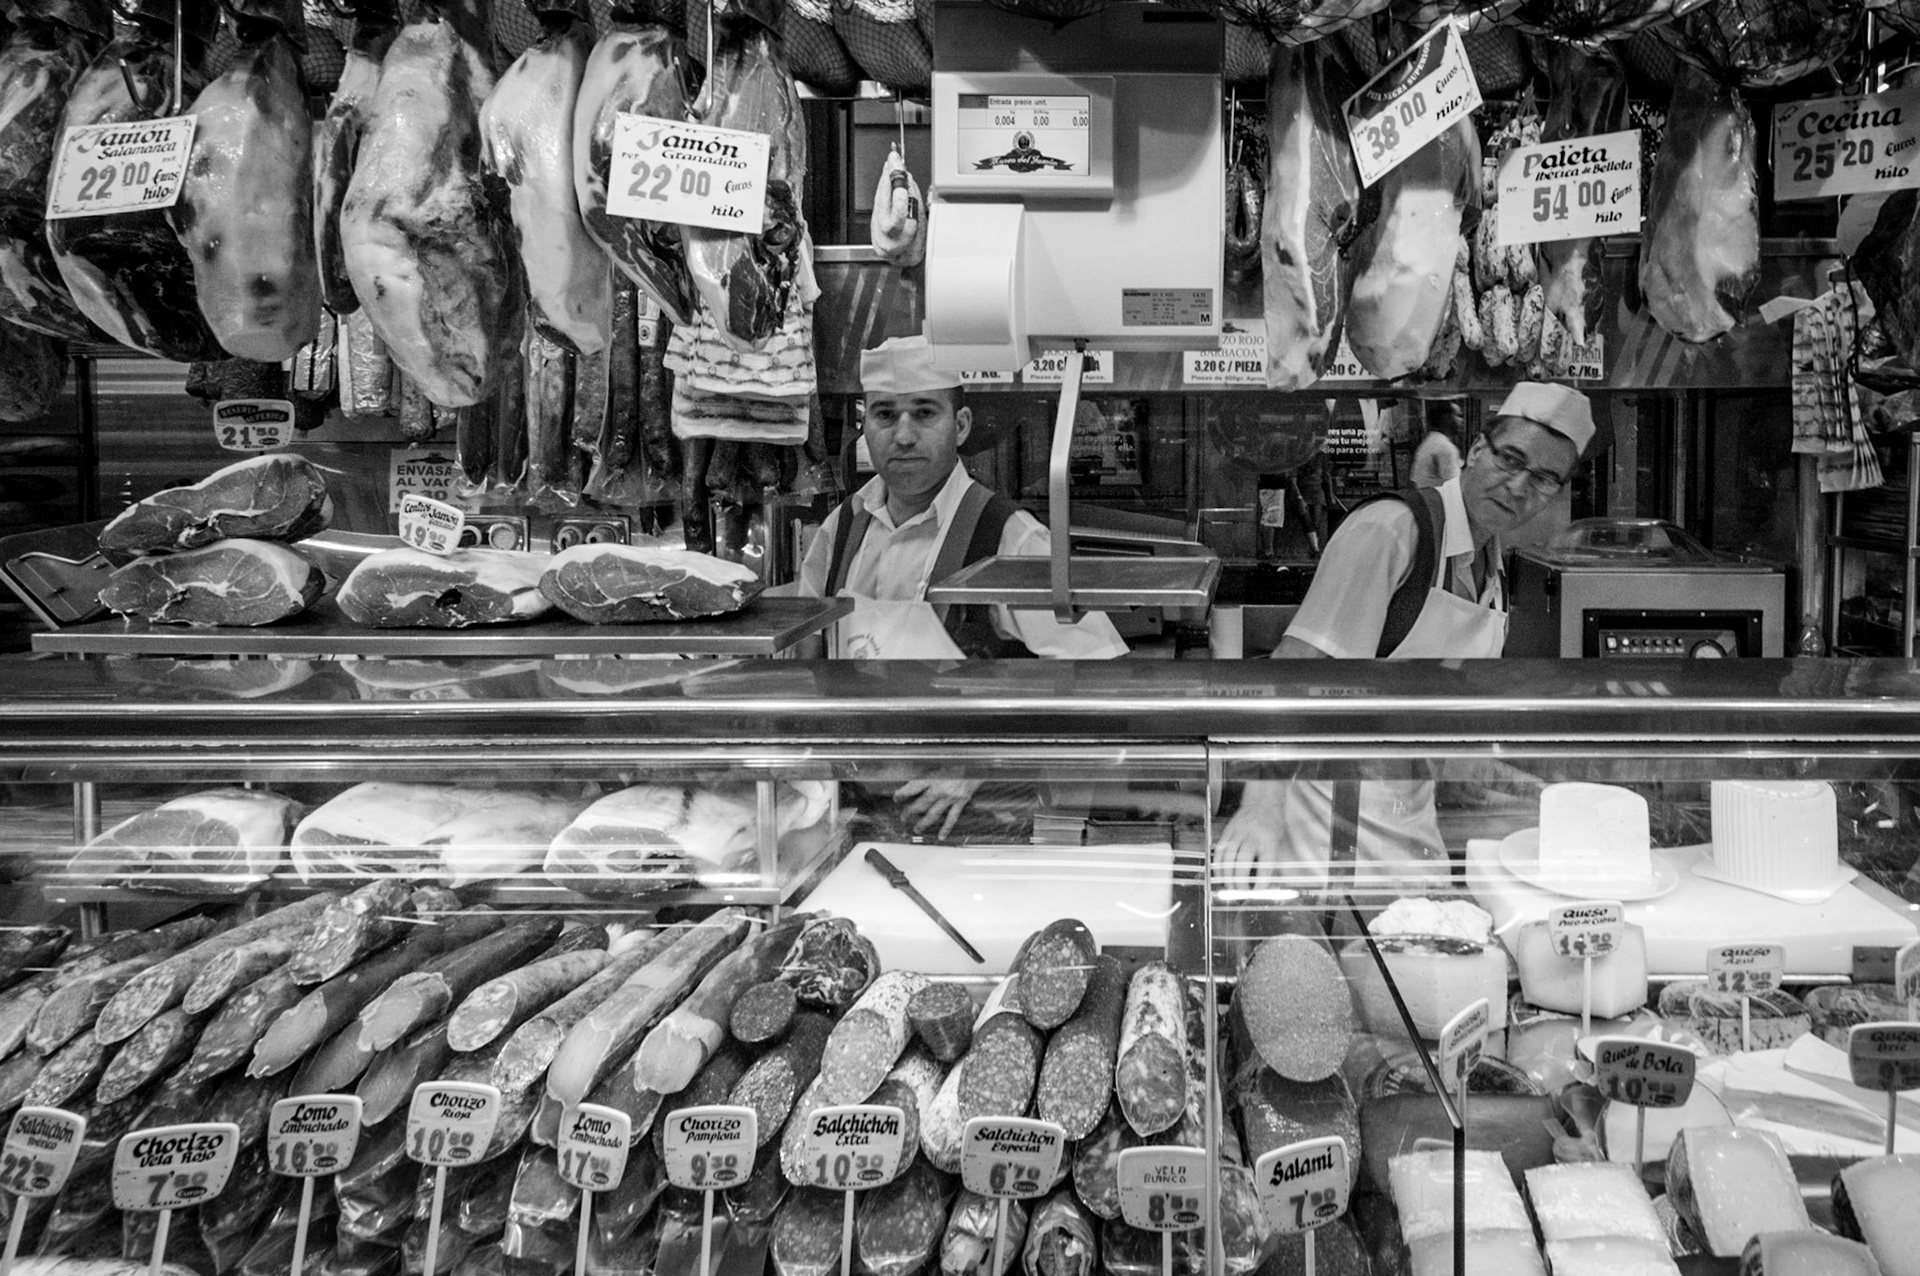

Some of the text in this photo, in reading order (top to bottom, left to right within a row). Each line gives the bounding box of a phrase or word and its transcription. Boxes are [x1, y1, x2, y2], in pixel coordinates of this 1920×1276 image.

[1383, 85, 1408, 101] NEGRA
[1407, 40, 1431, 86] SUPERIOR
[989, 98, 1012, 106] Entrada
[1014, 98, 1032, 107] precio
[994, 115, 1088, 126] 0,004 0,00 0,00
[1797, 105, 1903, 139] Cecina
[76, 128, 172, 154] Jamón
[636, 128, 739, 159] Jamón
[97, 141, 177, 160] Salamanca
[661, 149, 748, 169] Granadino
[989, 155, 1016, 166] Museo
[1017, 155, 1031, 164] del
[1522, 146, 1610, 179] Paleta
[1581, 166, 1591, 175] de
[1592, 159, 1633, 174] Bellota
[1200, 313, 1210, 323] M
[1238, 335, 1265, 346] ROJO
[1234, 360, 1262, 373] PIEZA
[1341, 428, 1356, 436] una
[1341, 437, 1350, 445] tu
[1336, 447, 1354, 455] para
[397, 465, 452, 476] ENVASA
[396, 477, 450, 487] AL VAC
[1563, 908, 1608, 918] Queso
[1721, 947, 1771, 958] Queso
[1602, 1045, 1640, 1064] Queso
[1625, 1051, 1684, 1074] de Bola
[429, 1091, 487, 1111] Chorizo
[290, 1103, 338, 1123] Lomo
[440, 1108, 472, 1121] Rioja
[15, 1115, 75, 1144] Salchichón
[279, 1118, 350, 1135] Embuchado
[572, 1111, 612, 1135] Lomo
[680, 1116, 741, 1133] Chorizo
[813, 1113, 899, 1138] Salchichón
[569, 1130, 623, 1149] Embuchado
[685, 1130, 741, 1144] Pamplona
[835, 1132, 870, 1147] Extra
[974, 1126, 1056, 1146] Salchichón
[132, 1131, 224, 1159] Chorizo
[991, 1141, 1040, 1154] Especial
[139, 1153, 173, 1168] Vela
[1269, 1145, 1336, 1187] Salami
[1155, 1165, 1187, 1175] VELA
